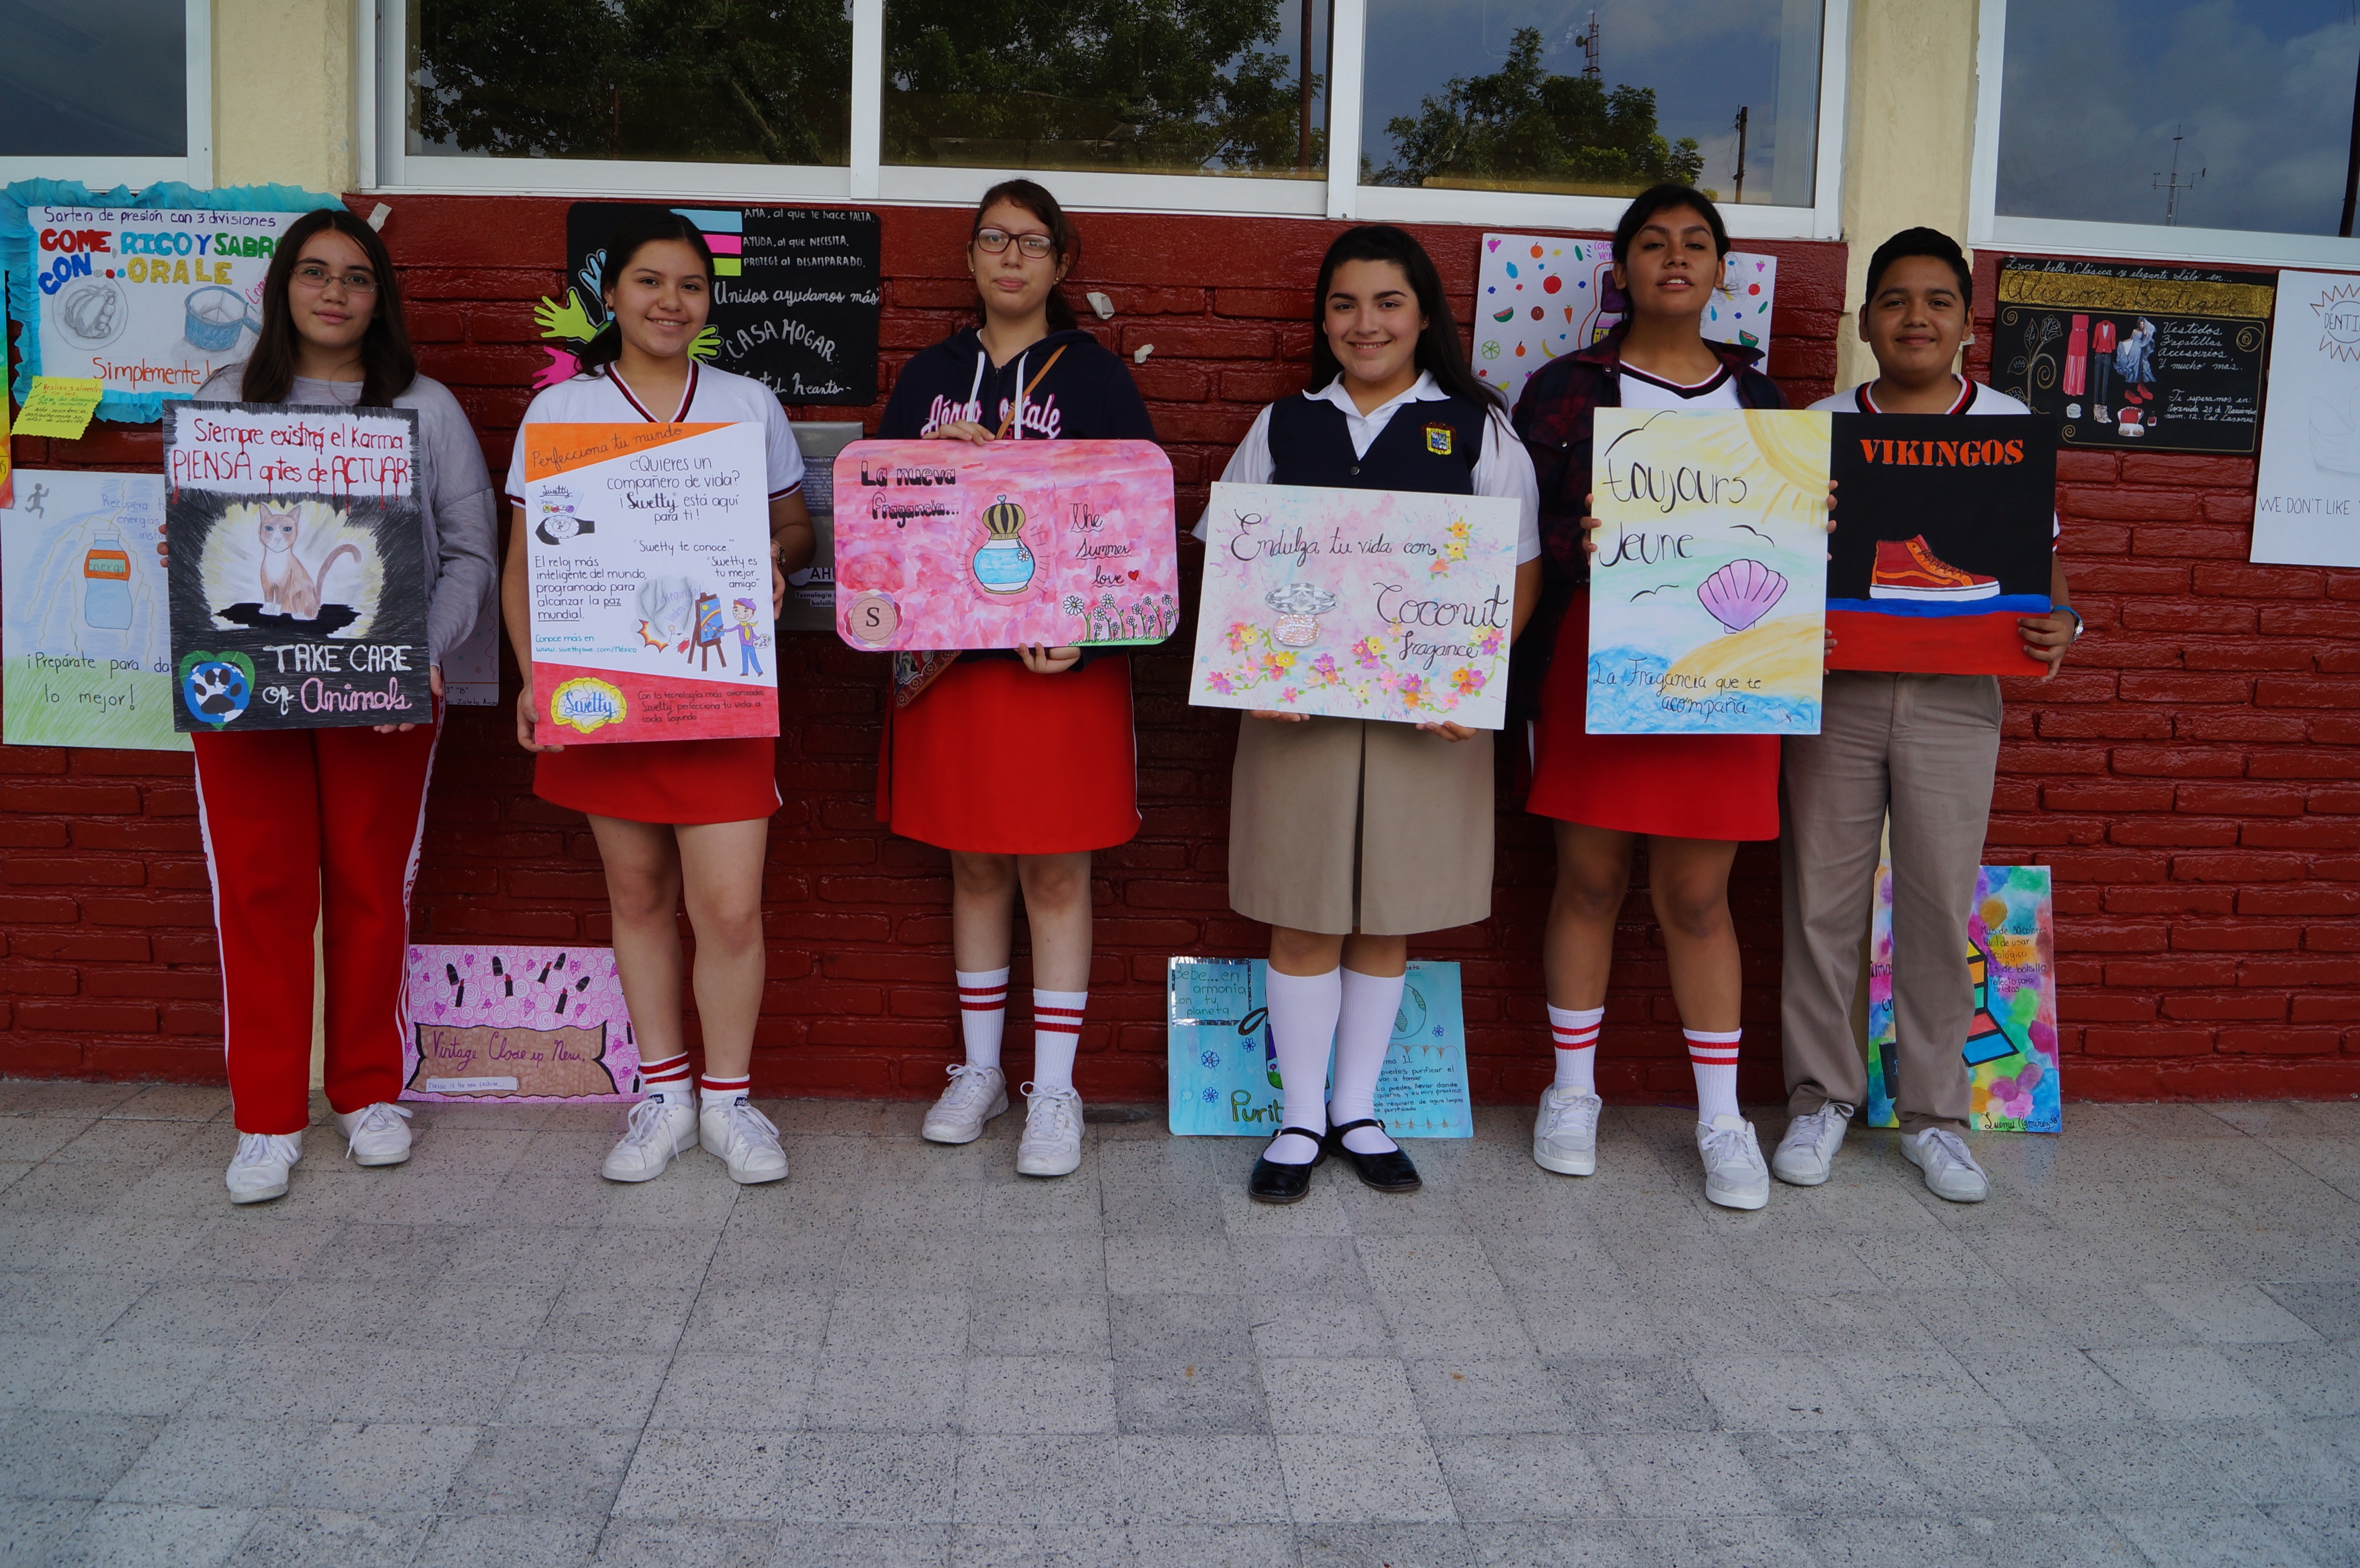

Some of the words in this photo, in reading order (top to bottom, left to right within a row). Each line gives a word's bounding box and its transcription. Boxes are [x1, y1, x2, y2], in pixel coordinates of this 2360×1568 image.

[44, 208, 93, 222] Sarten
[99, 208, 114, 221] de
[121, 210, 163, 227] presión
[171, 213, 193, 224] con
[197, 214, 205, 224] 3
[209, 213, 275, 228] divisiones
[773, 209, 783, 218] al
[787, 211, 806, 221] que
[823, 211, 846, 220] hace
[849, 211, 874, 222] FALTA.
[121, 232, 193, 255] RICO
[195, 234, 211, 255] Y
[777, 236, 786, 246] al
[789, 238, 806, 248] que
[810, 235, 849, 247] NECESITA.
[127, 257, 233, 284] ORALE
[743, 257, 778, 267] PROTEGE
[781, 257, 791, 266] al
[797, 257, 865, 268] DESAMPARADO.
[2005, 257, 2036, 271] Luce
[2042, 260, 2072, 274] bella,
[2129, 267, 2168, 281] elegante
[773, 288, 846, 306] ayudamos
[2134, 281, 2237, 315] Boutique
[2163, 321, 2223, 336] Vestidos
[725, 321, 779, 358] CASA
[781, 318, 837, 363] HOGAR
[2160, 335, 2223, 347] Zapatillas
[92, 357, 202, 390] Simplemente
[2169, 389, 2185, 402] Te
[2187, 396, 2232, 404] esperamos
[194, 417, 264, 455] Siempre
[270, 421, 324, 454] existirá
[331, 423, 345, 448] el
[351, 426, 403, 450] Karma
[531, 441, 608, 472] Perfecciona
[613, 433, 629, 450] tu
[633, 425, 683, 444] mundo
[1860, 439, 2024, 467] VIKINGOS
[172, 450, 252, 481] PIENSA
[259, 454, 302, 483] antes
[308, 457, 328, 483] de
[332, 455, 408, 483] ACTUAR
[694, 456, 712, 470] un
[607, 475, 680, 495] compañero
[684, 474, 700, 488] de
[704, 470, 740, 487] vida?
[860, 461, 887, 487] La
[896, 467, 956, 487] nueva
[1602, 457, 1747, 514] toujours
[102, 494, 149, 511] Recupera
[683, 493, 708, 507] está
[712, 495, 739, 513] aquí
[2259, 497, 2282, 513] WE
[2286, 498, 2322, 515] DON'T
[2326, 499, 2350, 516] LIKE
[1069, 503, 1104, 529] The
[679, 540, 690, 552] te
[1230, 508, 1320, 568] Endulza
[1329, 526, 1352, 555] tu
[1358, 533, 1392, 554] vida
[1403, 539, 1437, 555] con
[1599, 521, 1694, 567] Jeune
[534, 555, 548, 568] El
[549, 556, 571, 572] reloj
[575, 556, 600, 567] más
[536, 568, 588, 583] inteligente
[590, 567, 604, 579] del
[607, 568, 648, 581] mundo,
[1092, 565, 1125, 585] love
[536, 583, 606, 599] programado
[610, 584, 635, 596] para
[537, 596, 584, 607] alcanzar
[589, 596, 600, 607] la
[603, 598, 622, 612] paz
[1373, 582, 1509, 629] Coconut
[537, 608, 585, 621] mundial.
[865, 606, 880, 627] S
[535, 634, 562, 643] Conoce
[564, 634, 583, 643] más
[262, 645, 345, 673] TAKE
[349, 645, 412, 672] CARE
[1399, 630, 1479, 671] fragance
[27, 651, 96, 674] ¡Prepárate
[111, 659, 139, 679] para
[1593, 660, 1617, 686] La
[1626, 657, 1707, 697] Fragancia
[1716, 677, 1741, 697] que
[1746, 676, 1761, 689] te
[45, 683, 60, 703] lo
[79, 684, 135, 713] mejor!
[262, 686, 295, 715] of
[300, 676, 413, 712] Animals
[1661, 695, 1747, 723] acompaña
[1990, 950, 2027, 961] Ecológico
[1221, 971, 1239, 982] en
[2002, 961, 2012, 973] de
[2016, 963, 2046, 973] bolsillo
[1193, 983, 1246, 995] armonia
[1991, 976, 2016, 985] Perfecto
[2018, 978, 2033, 986] para
[1187, 1003, 1229, 1018] planeta
[433, 1030, 478, 1071] Vintage
[530, 1052, 544, 1067] up
[1412, 1066, 1442, 1076] purificar
[428, 1081, 447, 1090] Classic
[1384, 1106, 1416, 1115] purificada
